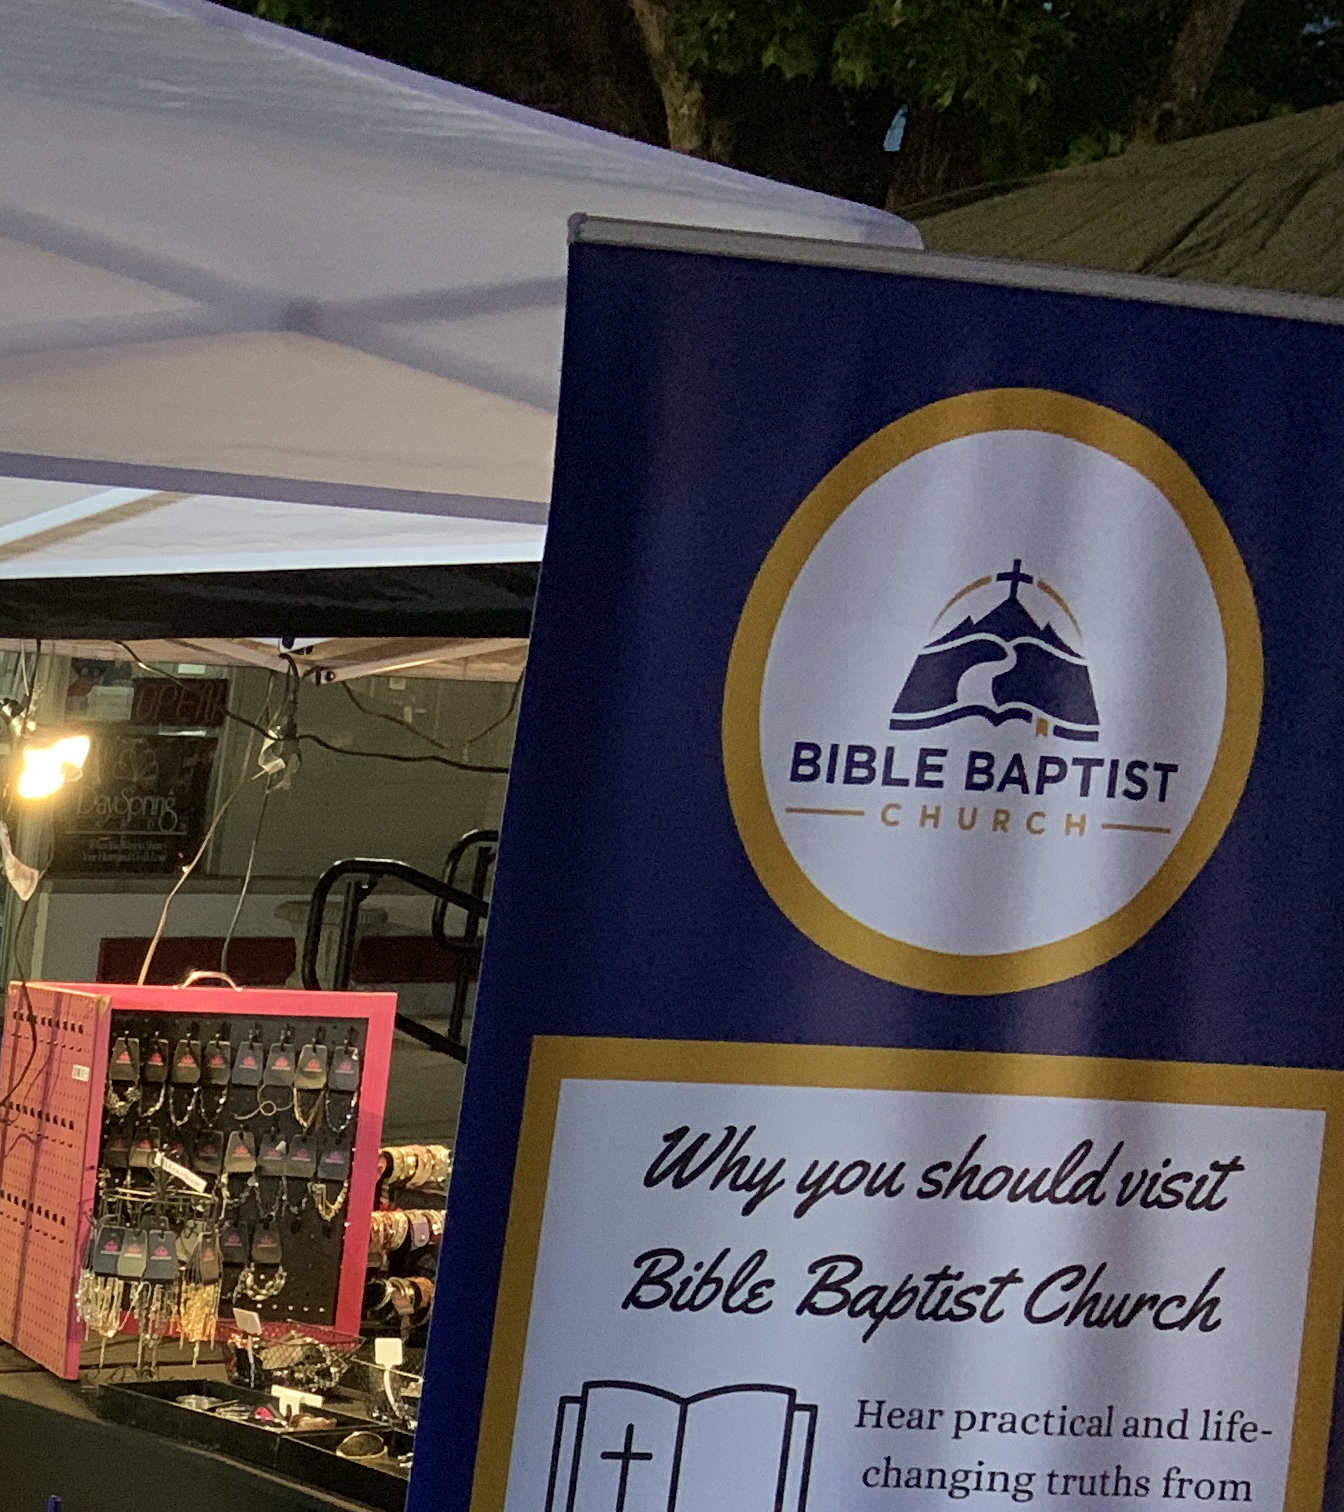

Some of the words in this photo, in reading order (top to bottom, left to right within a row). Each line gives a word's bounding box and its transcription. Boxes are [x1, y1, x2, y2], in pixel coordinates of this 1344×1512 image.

[790, 742, 948, 788] BIBLE
[965, 751, 1178, 802] BAPTIST
[881, 804, 1086, 836] CHURCH
[644, 1125, 786, 1216] Why
[794, 1164, 905, 1219] you
[916, 1134, 1121, 1207] should
[1116, 1156, 1245, 1211] visit
[621, 1248, 775, 1314] Bible
[796, 1255, 1023, 1343] Baptist
[1024, 1262, 1225, 1332] Church
[855, 1400, 944, 1430] Hear
[953, 1405, 1113, 1439] practical
[1123, 1408, 1188, 1440] and
[1200, 1409, 1272, 1443] life-
[862, 1456, 1036, 1502] changing
[1047, 1465, 1150, 1497] truths
[1163, 1467, 1251, 1501] from
